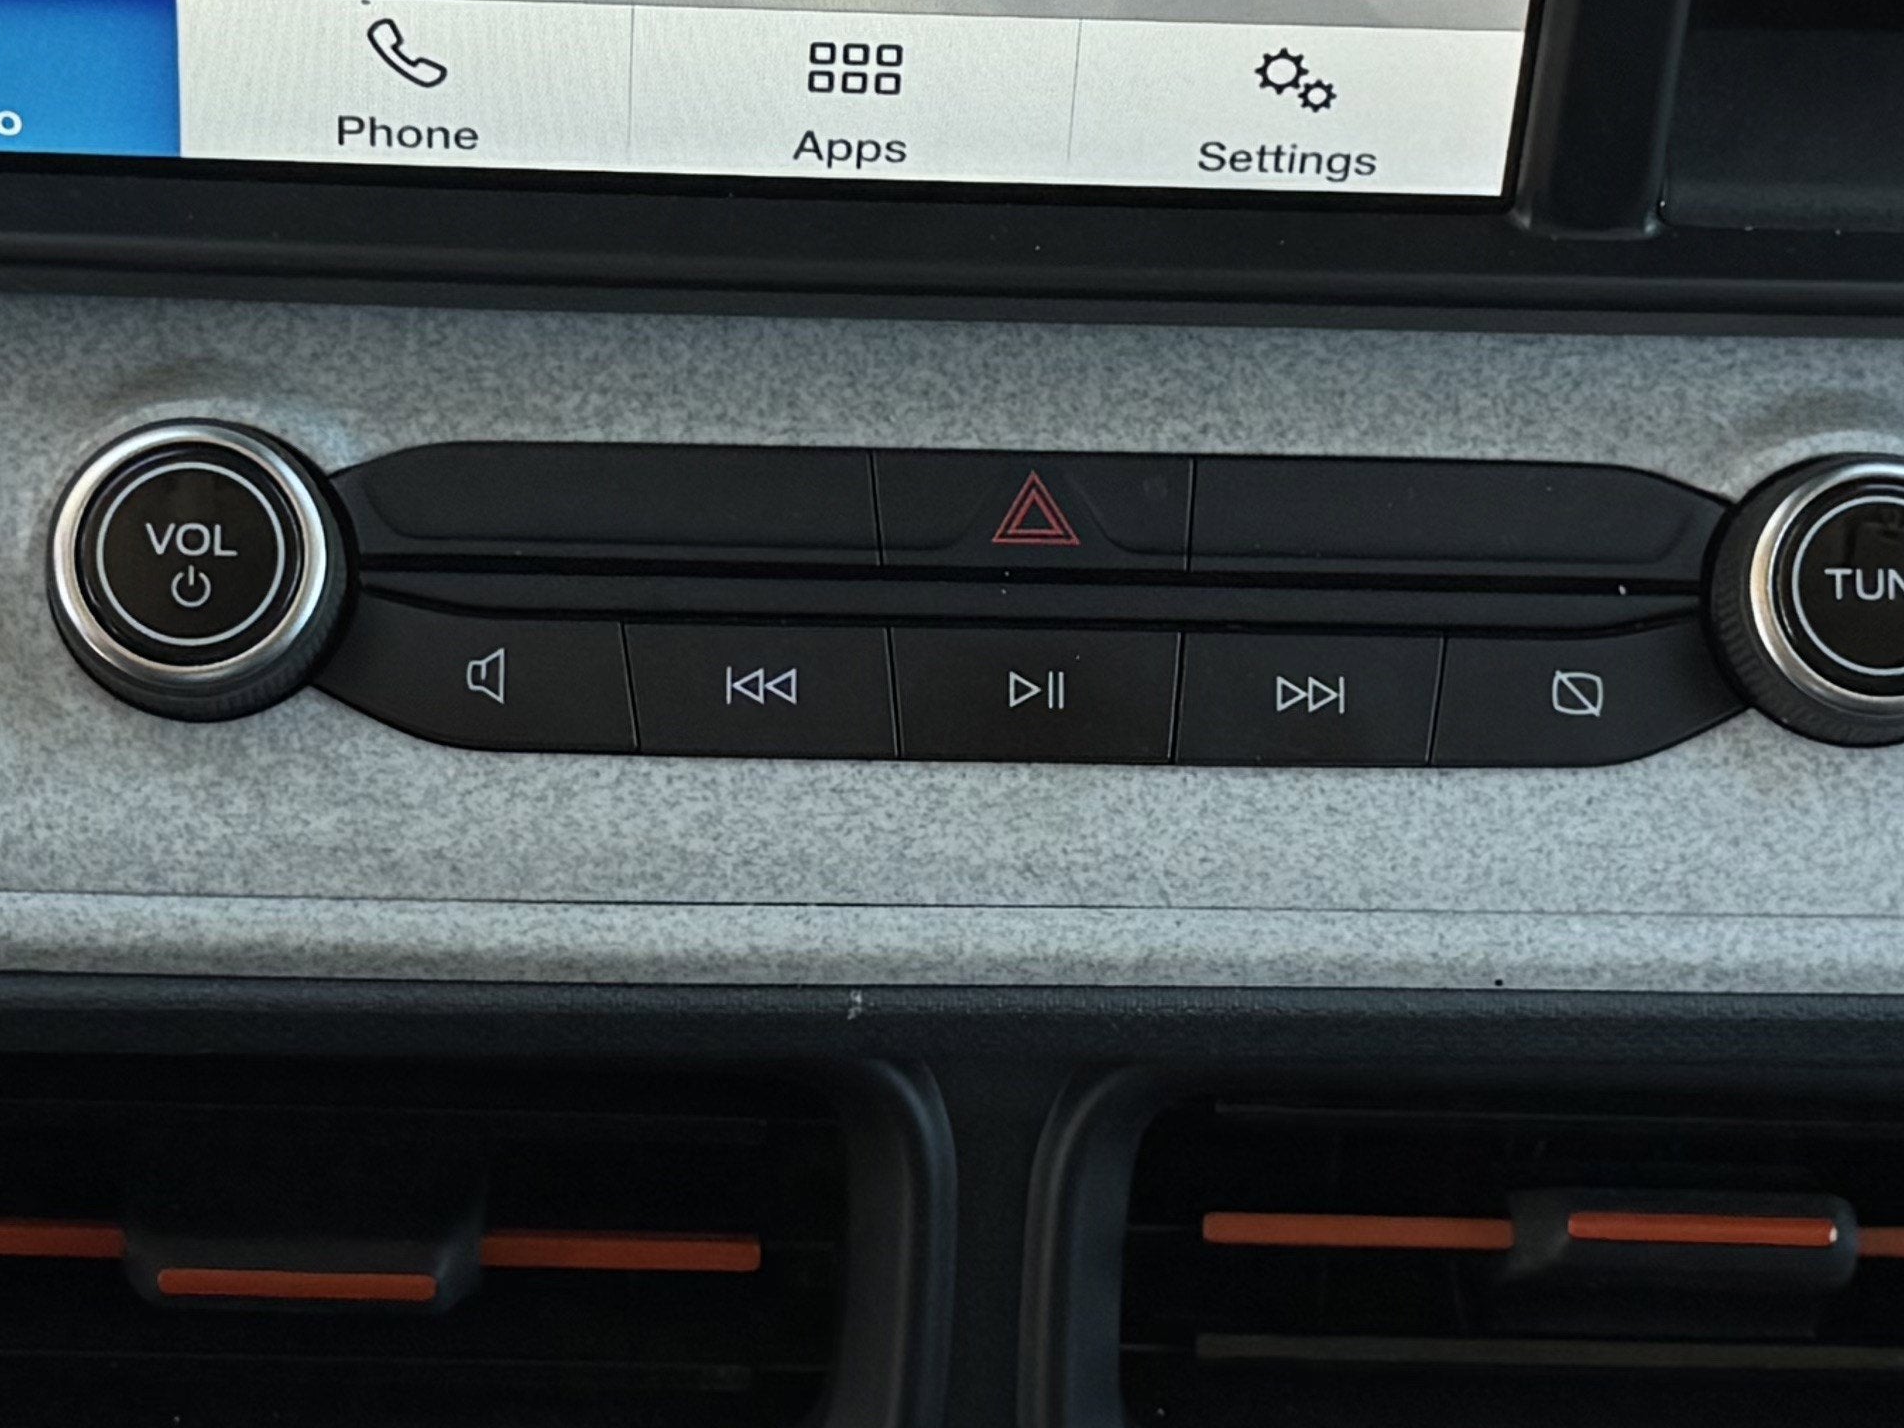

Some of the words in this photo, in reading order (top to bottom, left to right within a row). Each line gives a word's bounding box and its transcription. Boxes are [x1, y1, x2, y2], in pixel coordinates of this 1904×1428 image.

[337, 115, 479, 151] Phone
[792, 129, 907, 170] Apps
[1197, 141, 1377, 183] Settings
[145, 522, 238, 557] VOL
